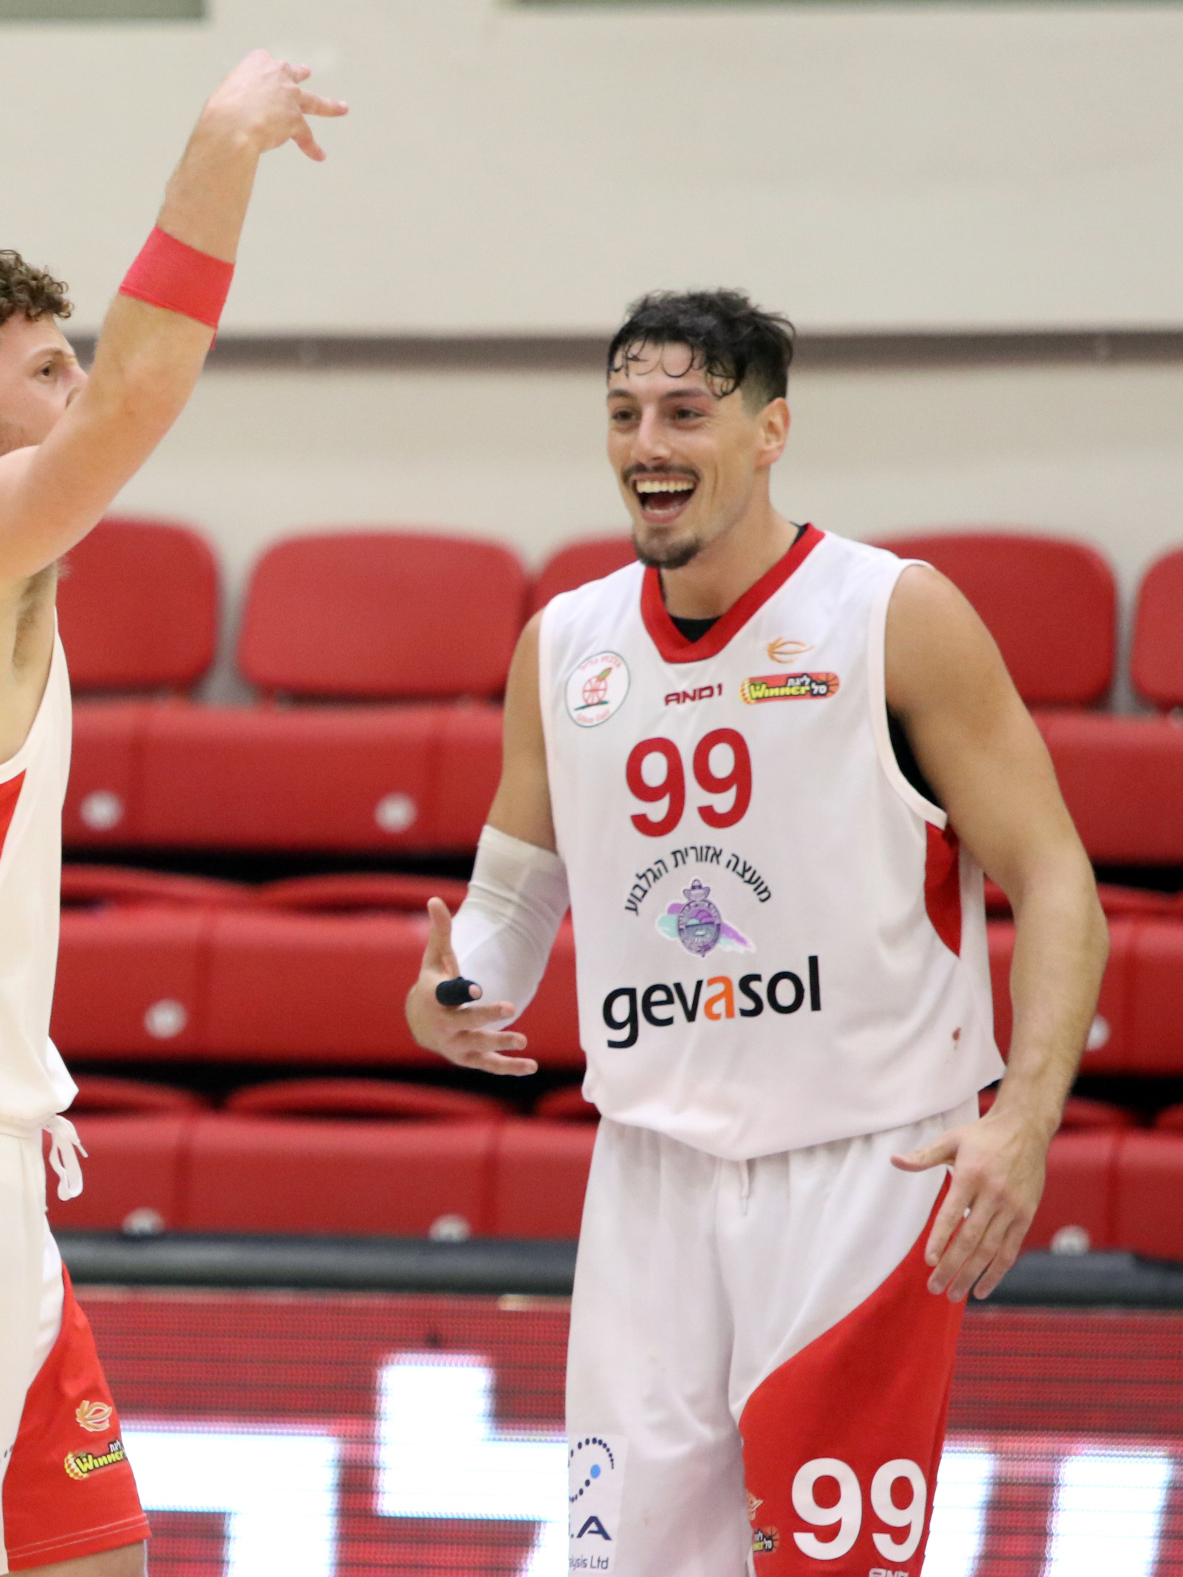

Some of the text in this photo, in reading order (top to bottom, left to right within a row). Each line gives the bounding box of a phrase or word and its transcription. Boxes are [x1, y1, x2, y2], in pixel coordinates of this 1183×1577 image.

[664, 684, 723, 706] AND1
[749, 683, 810, 700] Winner
[625, 727, 752, 838] 99
[670, 844, 724, 869] אזורית
[624, 858, 669, 916] הגלבוע
[725, 853, 772, 904] מועצה
[602, 955, 822, 1049] gevasol
[75, 1450, 124, 1472] Winner
[791, 1457, 928, 1563] 99
[590, 1555, 609, 1570] Ltd
